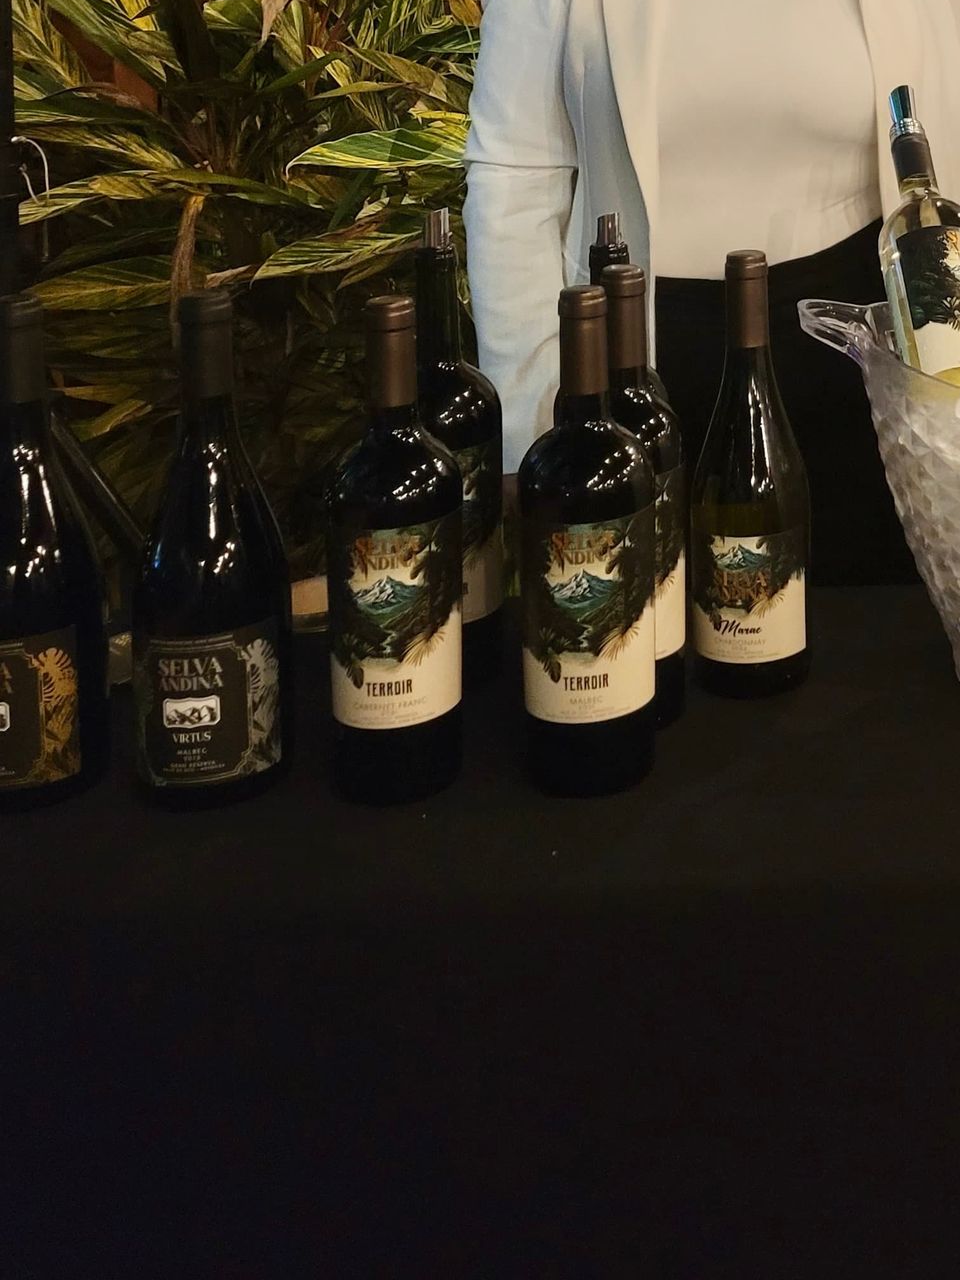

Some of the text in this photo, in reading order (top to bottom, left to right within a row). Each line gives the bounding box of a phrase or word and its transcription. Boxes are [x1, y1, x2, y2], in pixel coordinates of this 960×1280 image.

[158, 657, 223, 677] SELVA
[160, 674, 223, 692] ANDINA
[365, 679, 413, 697] TERROIR
[563, 673, 609, 692] TERROIR
[172, 730, 212, 744] VIRTUS
